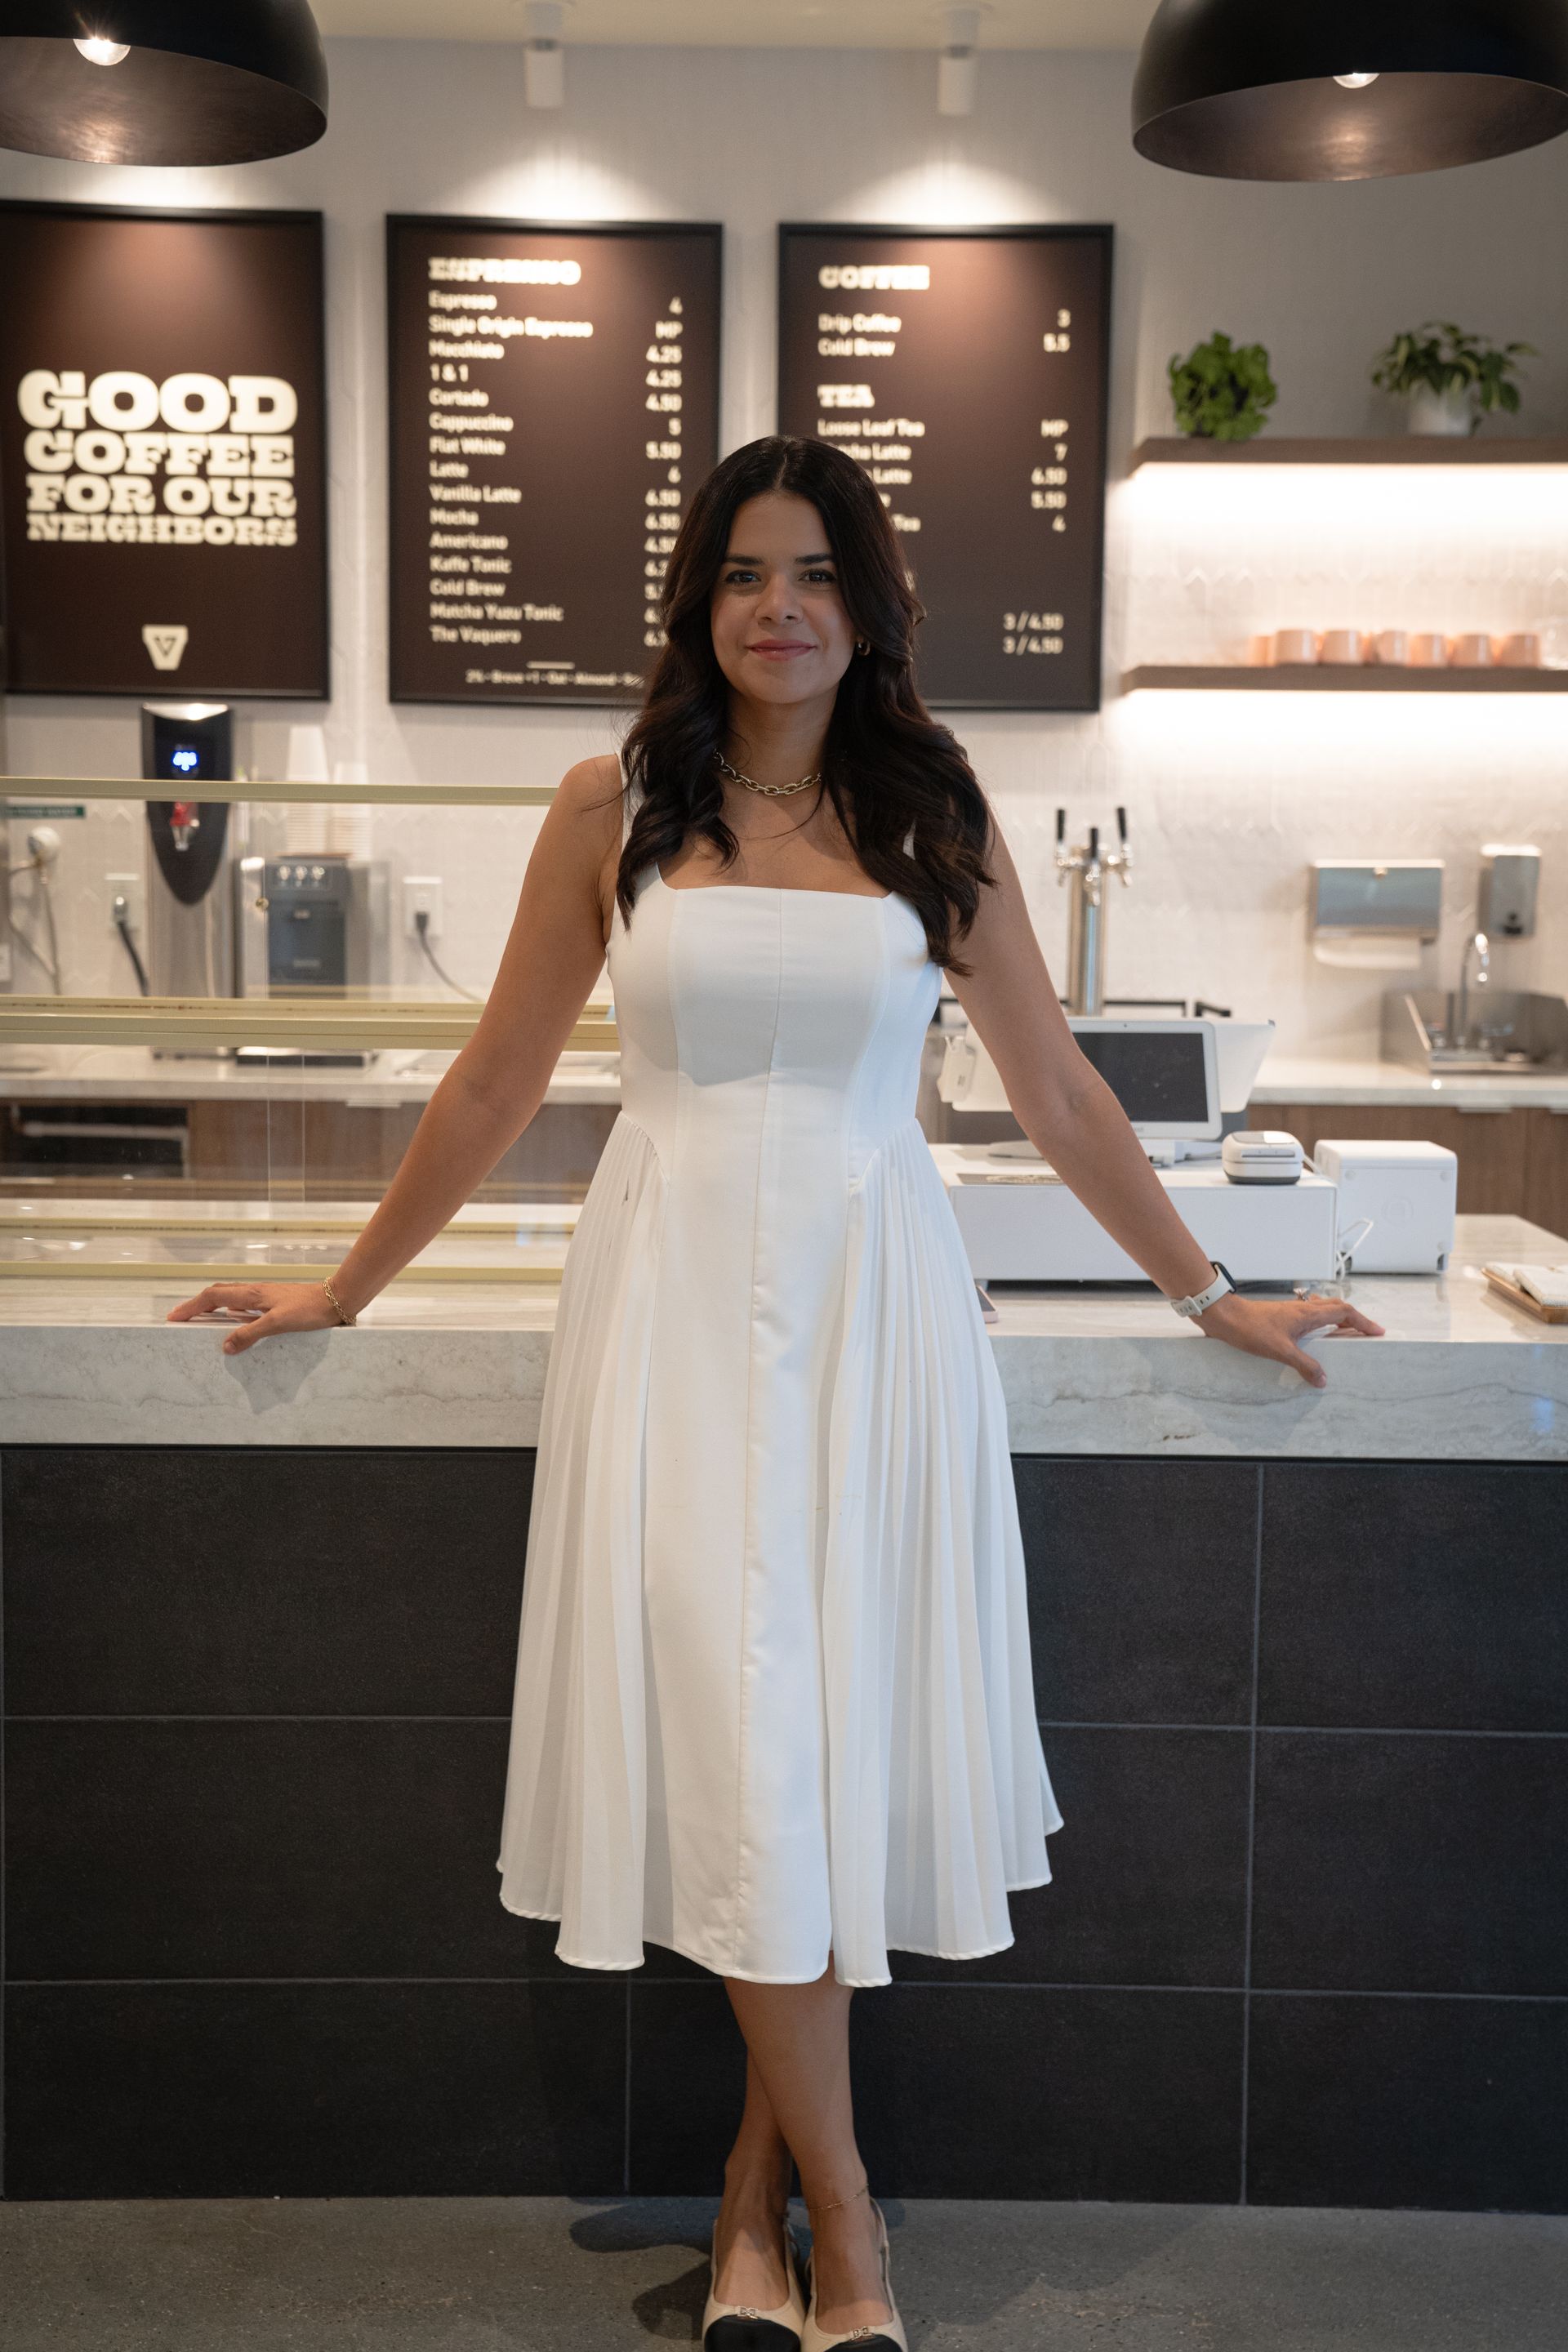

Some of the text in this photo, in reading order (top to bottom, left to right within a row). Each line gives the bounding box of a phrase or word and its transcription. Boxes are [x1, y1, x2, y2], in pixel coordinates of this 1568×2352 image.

[429, 290, 497, 312] Espresso
[669, 297, 683, 314] 4
[429, 314, 593, 340] Single Origin Espresso
[818, 313, 902, 334] Drip Coffee
[1057, 309, 1071, 327] 3
[656, 321, 683, 339] MP
[429, 339, 505, 359] Macchiato
[646, 345, 682, 363] 4.25
[817, 337, 895, 357] Cold Brew
[430, 363, 469, 382] 1 & 1
[646, 369, 682, 388] 4.25
[17, 369, 298, 434] GOOD
[429, 388, 489, 407] Cortado
[817, 384, 875, 408] TEA
[429, 412, 514, 433] Cappuccino
[668, 418, 681, 435] 5
[817, 418, 925, 437] Loose Leaf Tea
[1041, 420, 1068, 437] MP
[24, 430, 295, 478] COFFEE
[430, 436, 506, 455] Flat White
[872, 443, 912, 461] Latte
[1055, 443, 1068, 461] 7
[430, 461, 469, 478] Latte
[667, 466, 681, 483] 6
[873, 466, 912, 484] Latte
[25, 474, 297, 516] FOR OUR
[430, 484, 522, 503] Vanilla Latte
[430, 508, 479, 525] Mocha
[1052, 515, 1067, 532] 4
[27, 513, 297, 546] NEIGHBORS
[430, 532, 508, 550] Americano
[430, 555, 511, 573] Kaffe Tonic
[430, 578, 506, 596] Cold Brew
[430, 602, 564, 621] Matcha Yuzu Tonic
[430, 626, 522, 645] The Vaquero
